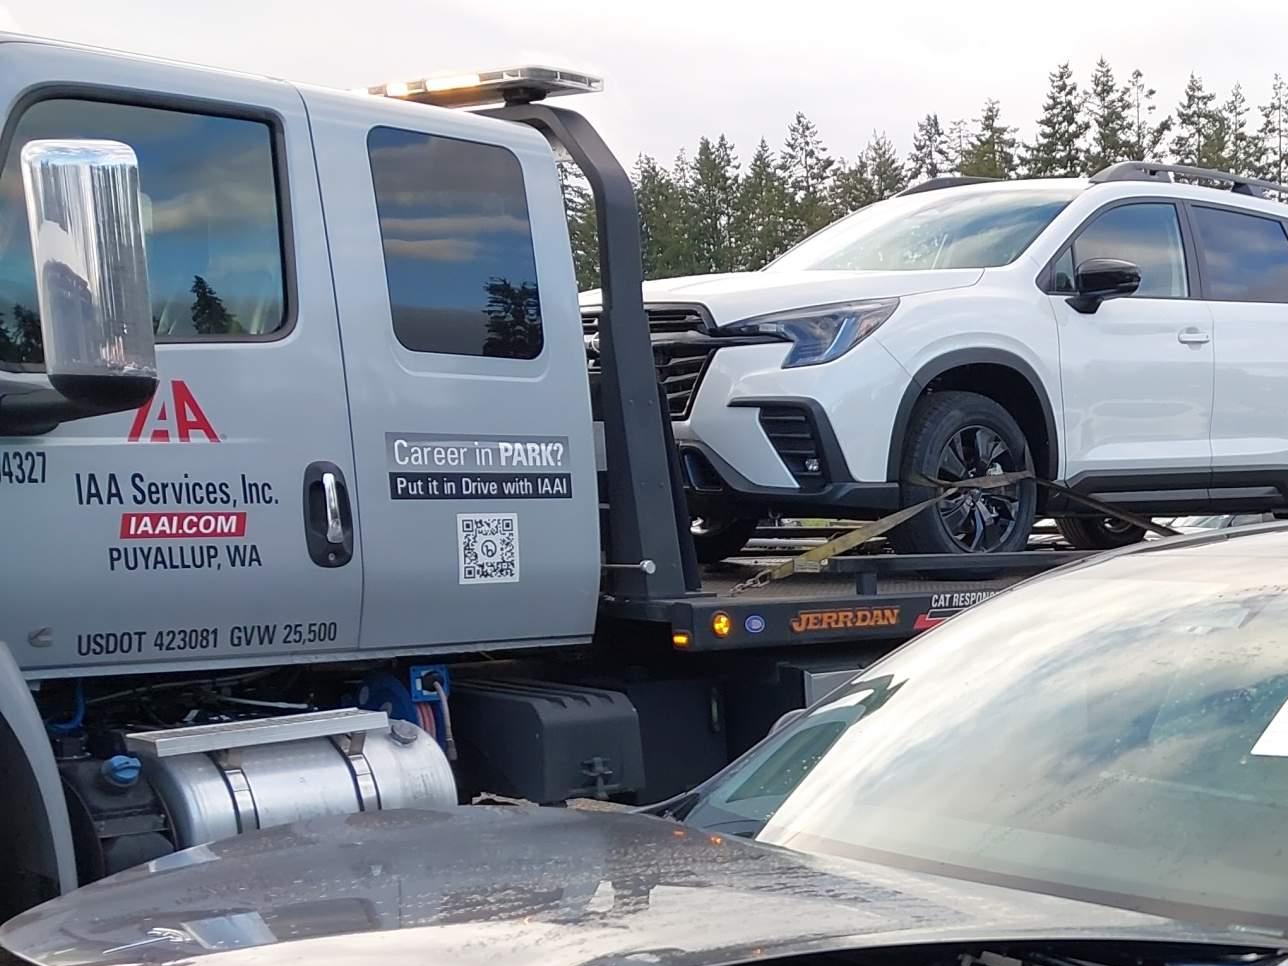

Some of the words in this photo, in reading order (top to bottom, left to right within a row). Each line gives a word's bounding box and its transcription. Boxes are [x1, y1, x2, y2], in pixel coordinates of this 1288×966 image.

[394, 439, 468, 466] Career
[475, 442, 493, 466] in
[498, 442, 564, 467] PARK?
[0, 451, 47, 484] 4327
[75, 472, 124, 505] IAA
[130, 472, 237, 508] Services,
[241, 473, 279, 505] Inc.
[396, 477, 424, 495] Put
[428, 477, 439, 495] it
[443, 477, 456, 495] in
[462, 477, 498, 495] Drive
[502, 477, 533, 495] with
[538, 477, 567, 495] IAAI
[129, 514, 237, 536] IAAI.COM
[109, 545, 222, 572] PUYALLUP,
[226, 544, 262, 568] WA
[931, 593, 951, 608] CAT
[952, 591, 1000, 607] RESPON
[77, 631, 147, 656] USDOT
[153, 627, 219, 652] 423081
[230, 624, 277, 647] GVW
[282, 621, 338, 646] 25,500
